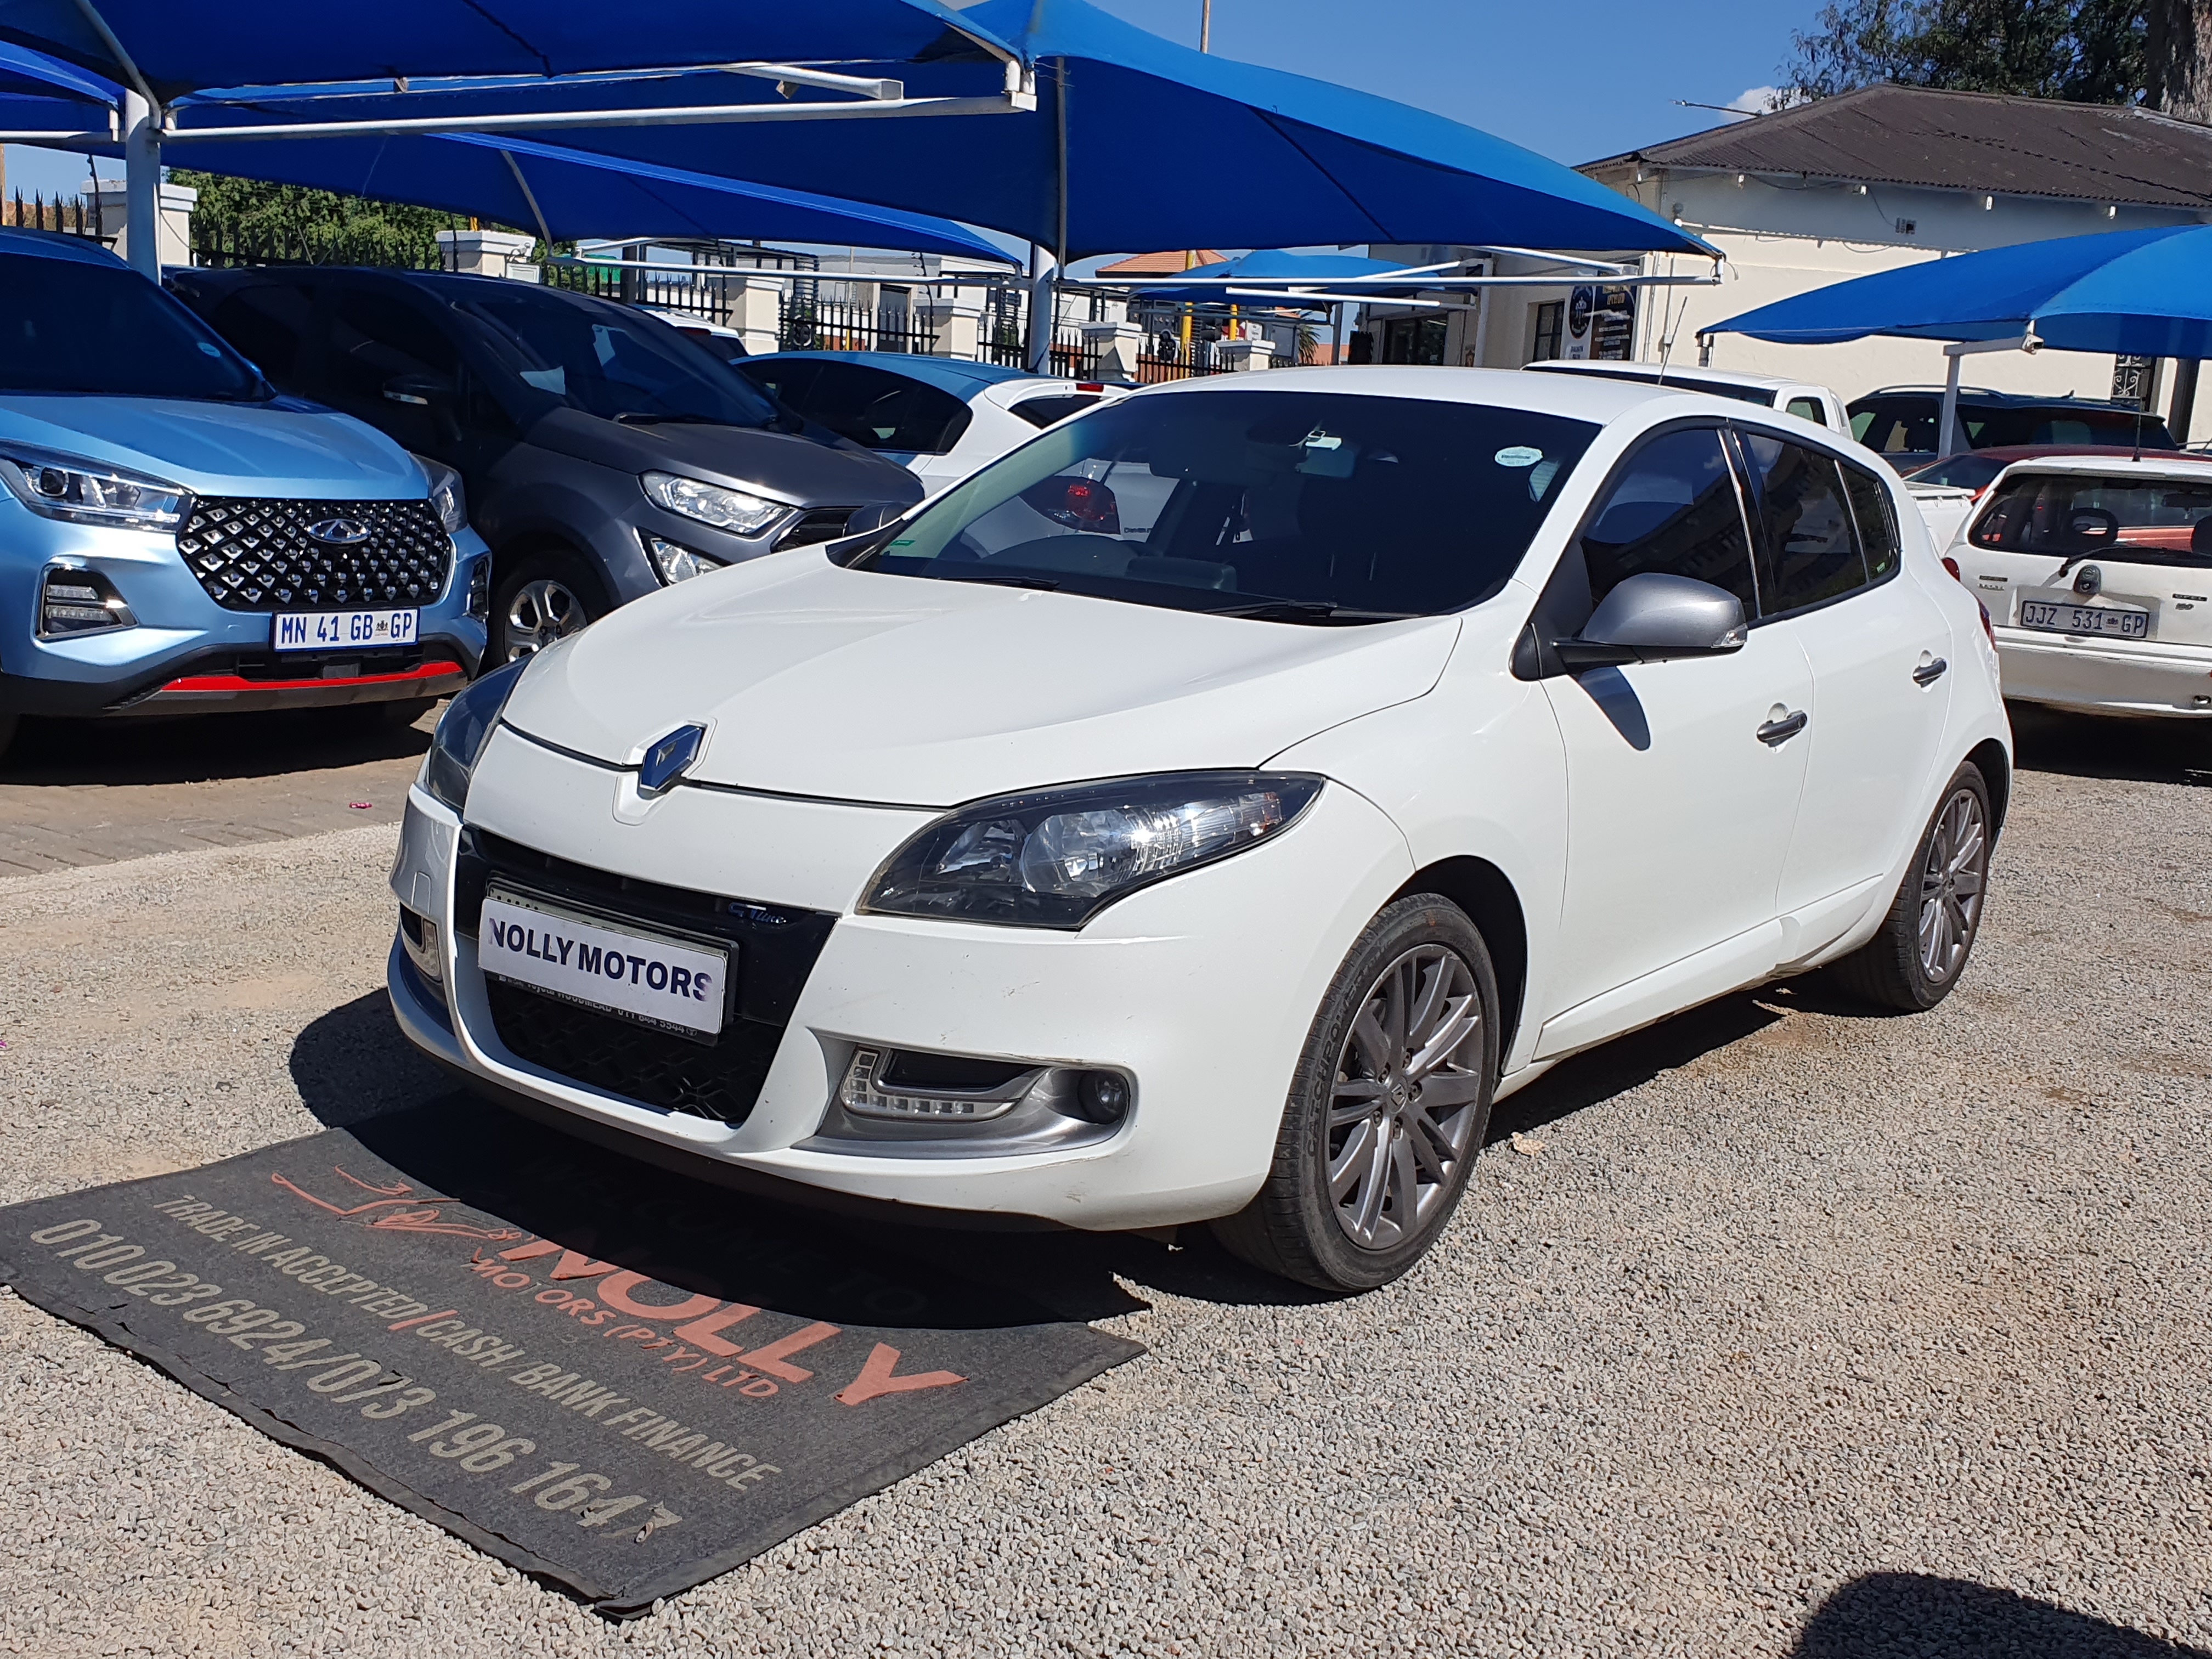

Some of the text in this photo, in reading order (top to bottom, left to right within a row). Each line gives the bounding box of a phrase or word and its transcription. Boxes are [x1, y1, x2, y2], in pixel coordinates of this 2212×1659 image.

[281, 612, 413, 644] MN 41 GB GP
[2025, 605, 2145, 634] JJZ 531 GP
[488, 918, 713, 1002] NOLLY MOTORS
[30, 1219, 146, 1272] 010
[103, 1260, 223, 1306] 023
[407, 1408, 537, 1474] 196
[154, 1194, 259, 1243] TRADE
[232, 1232, 292, 1255] IN
[603, 1405, 783, 1491] FINANCE
[498, 1227, 970, 1406] NOLLY
[702, 1363, 780, 1398] LTD
